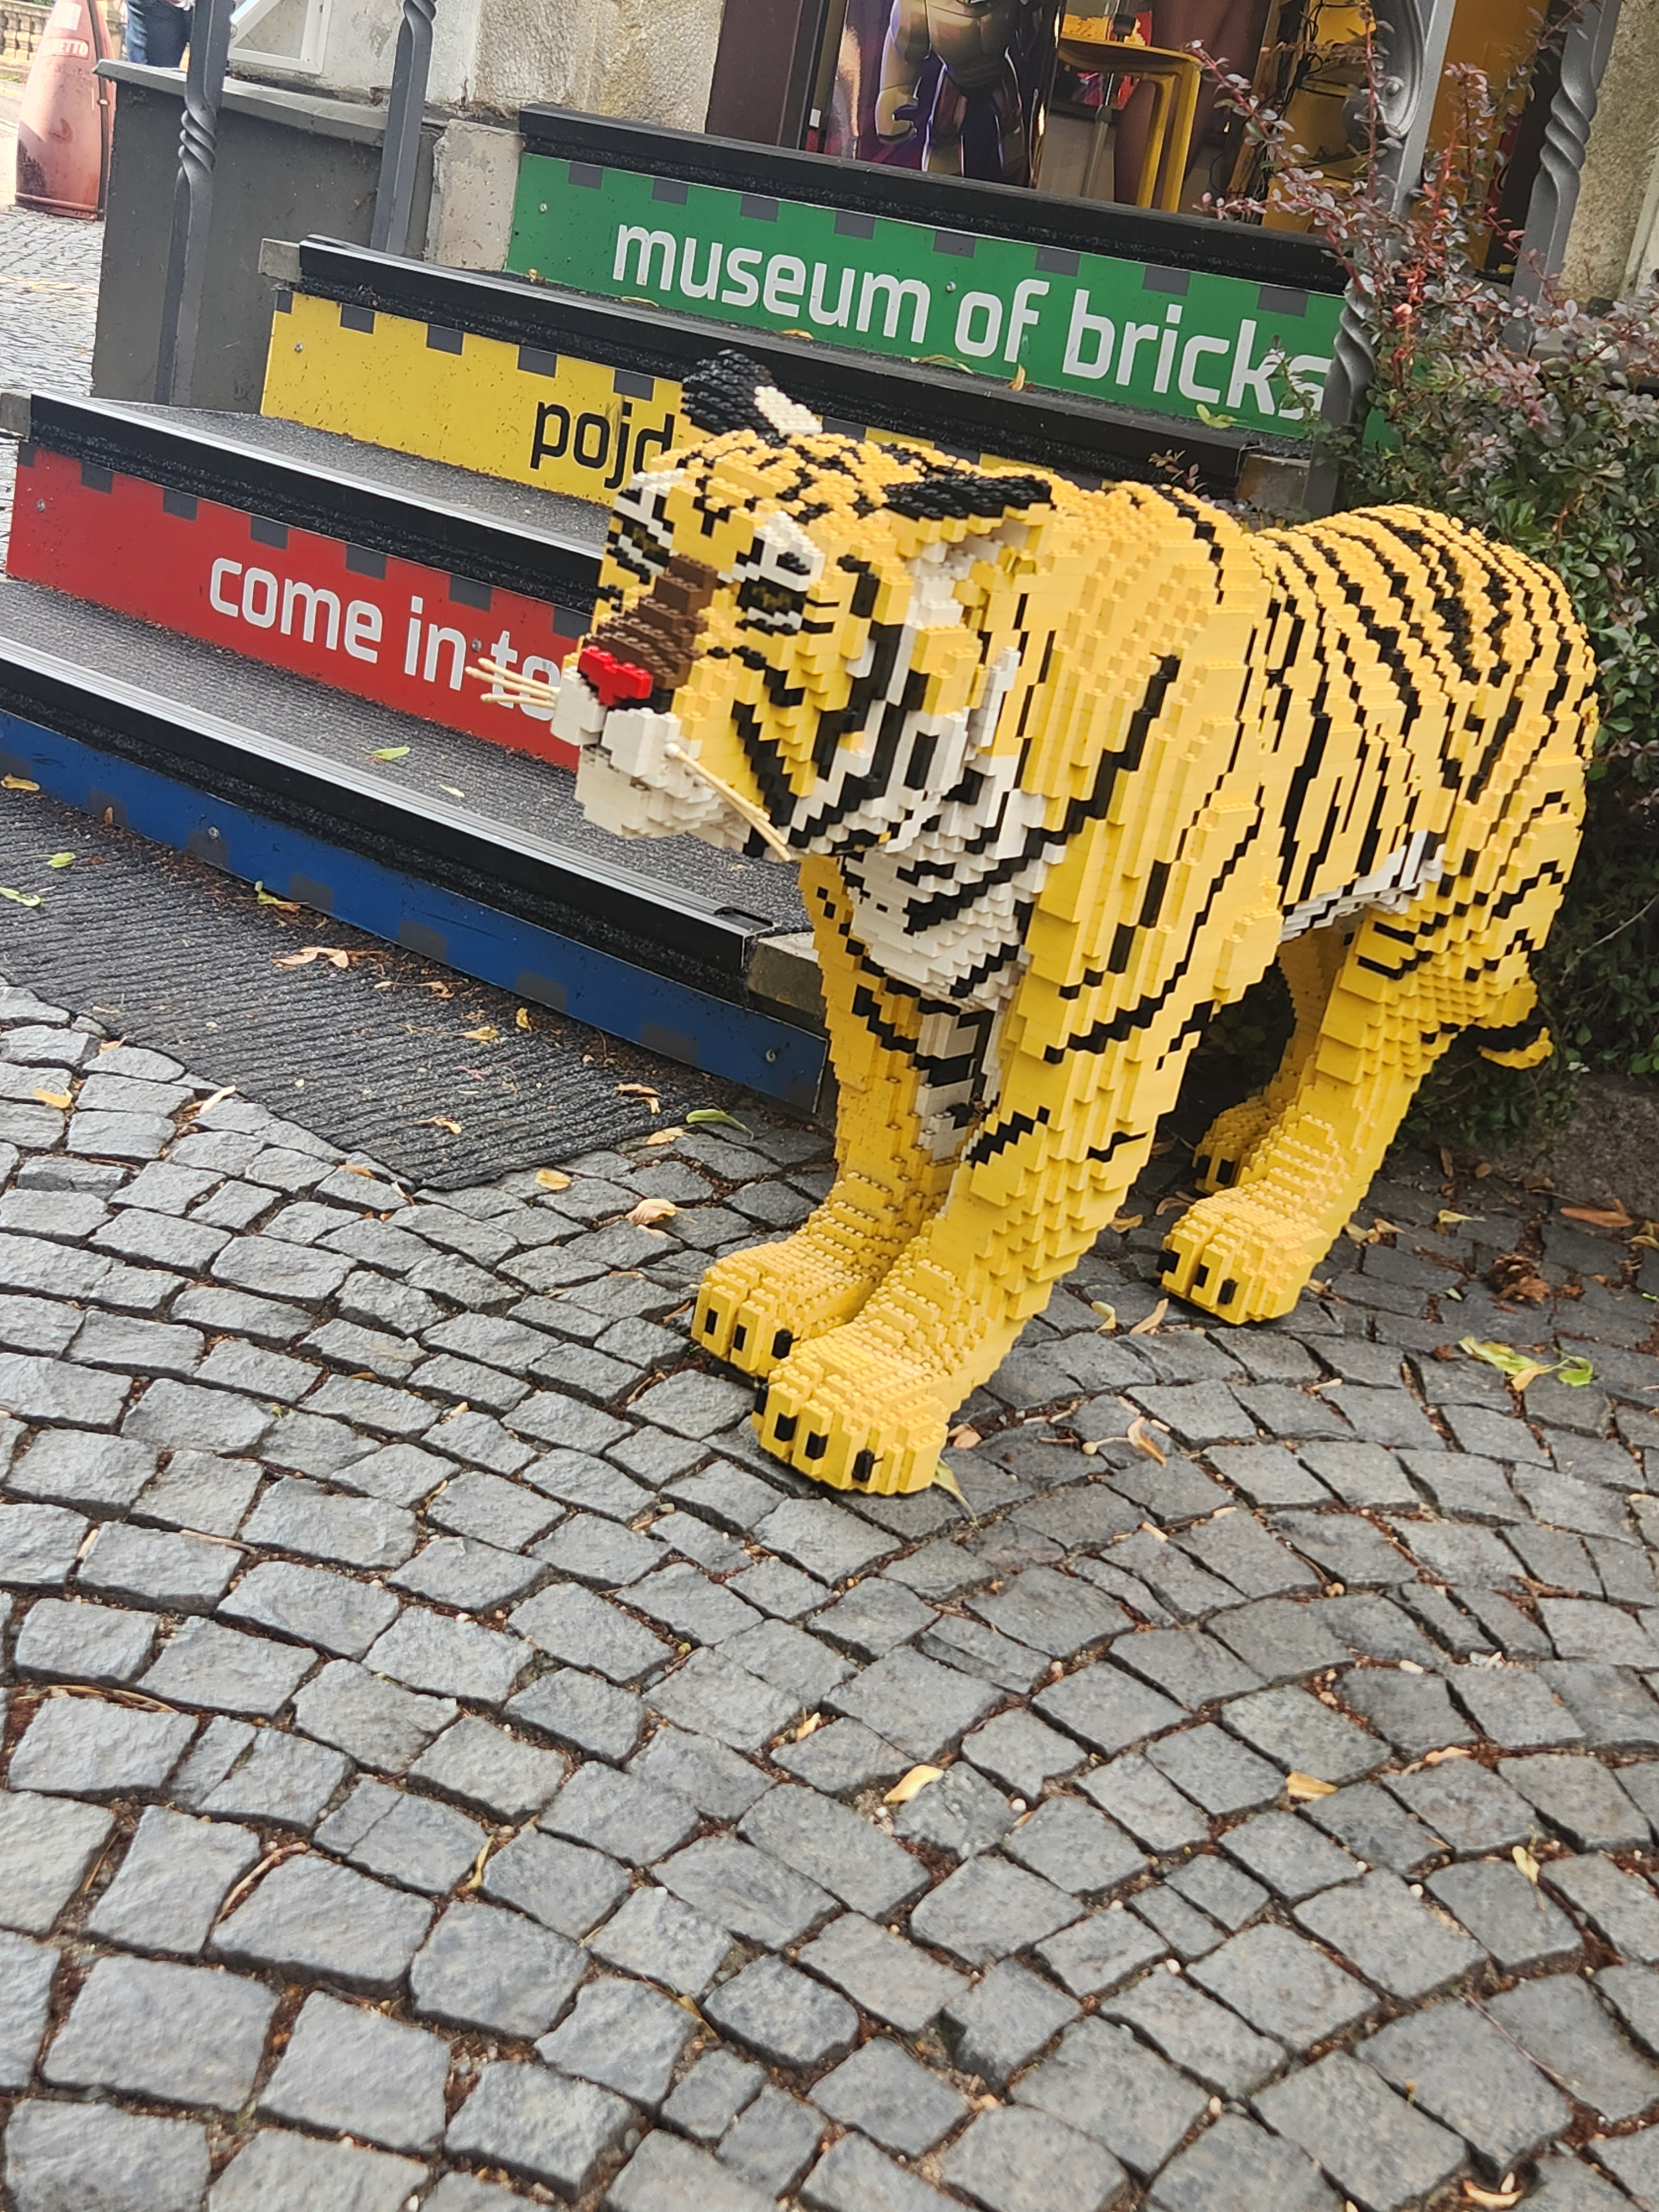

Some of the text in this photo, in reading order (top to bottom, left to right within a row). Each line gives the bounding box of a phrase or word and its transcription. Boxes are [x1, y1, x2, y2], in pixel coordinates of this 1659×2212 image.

[612, 224, 1332, 421] museum of bricks
[210, 557, 560, 721] come in to
